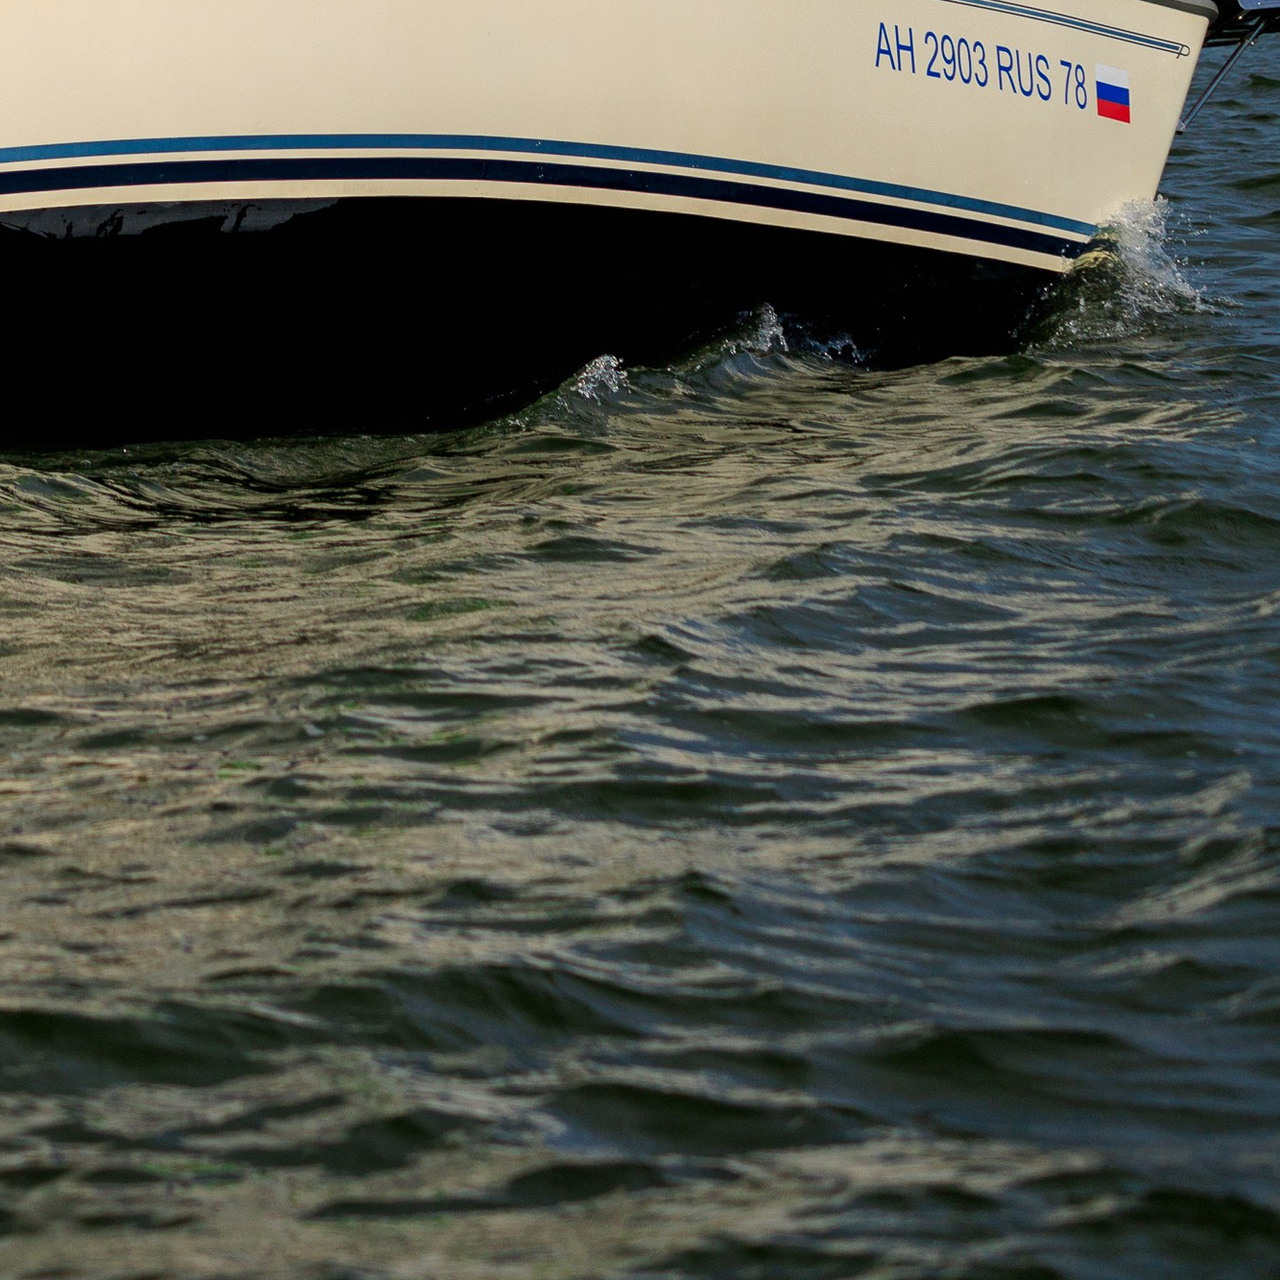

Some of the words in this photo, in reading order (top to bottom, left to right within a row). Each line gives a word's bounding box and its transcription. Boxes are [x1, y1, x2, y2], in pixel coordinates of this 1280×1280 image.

[875, 22, 916, 74] AH
[924, 31, 988, 87] 2903
[996, 45, 1052, 101] RUS
[1059, 59, 1087, 109] 78
